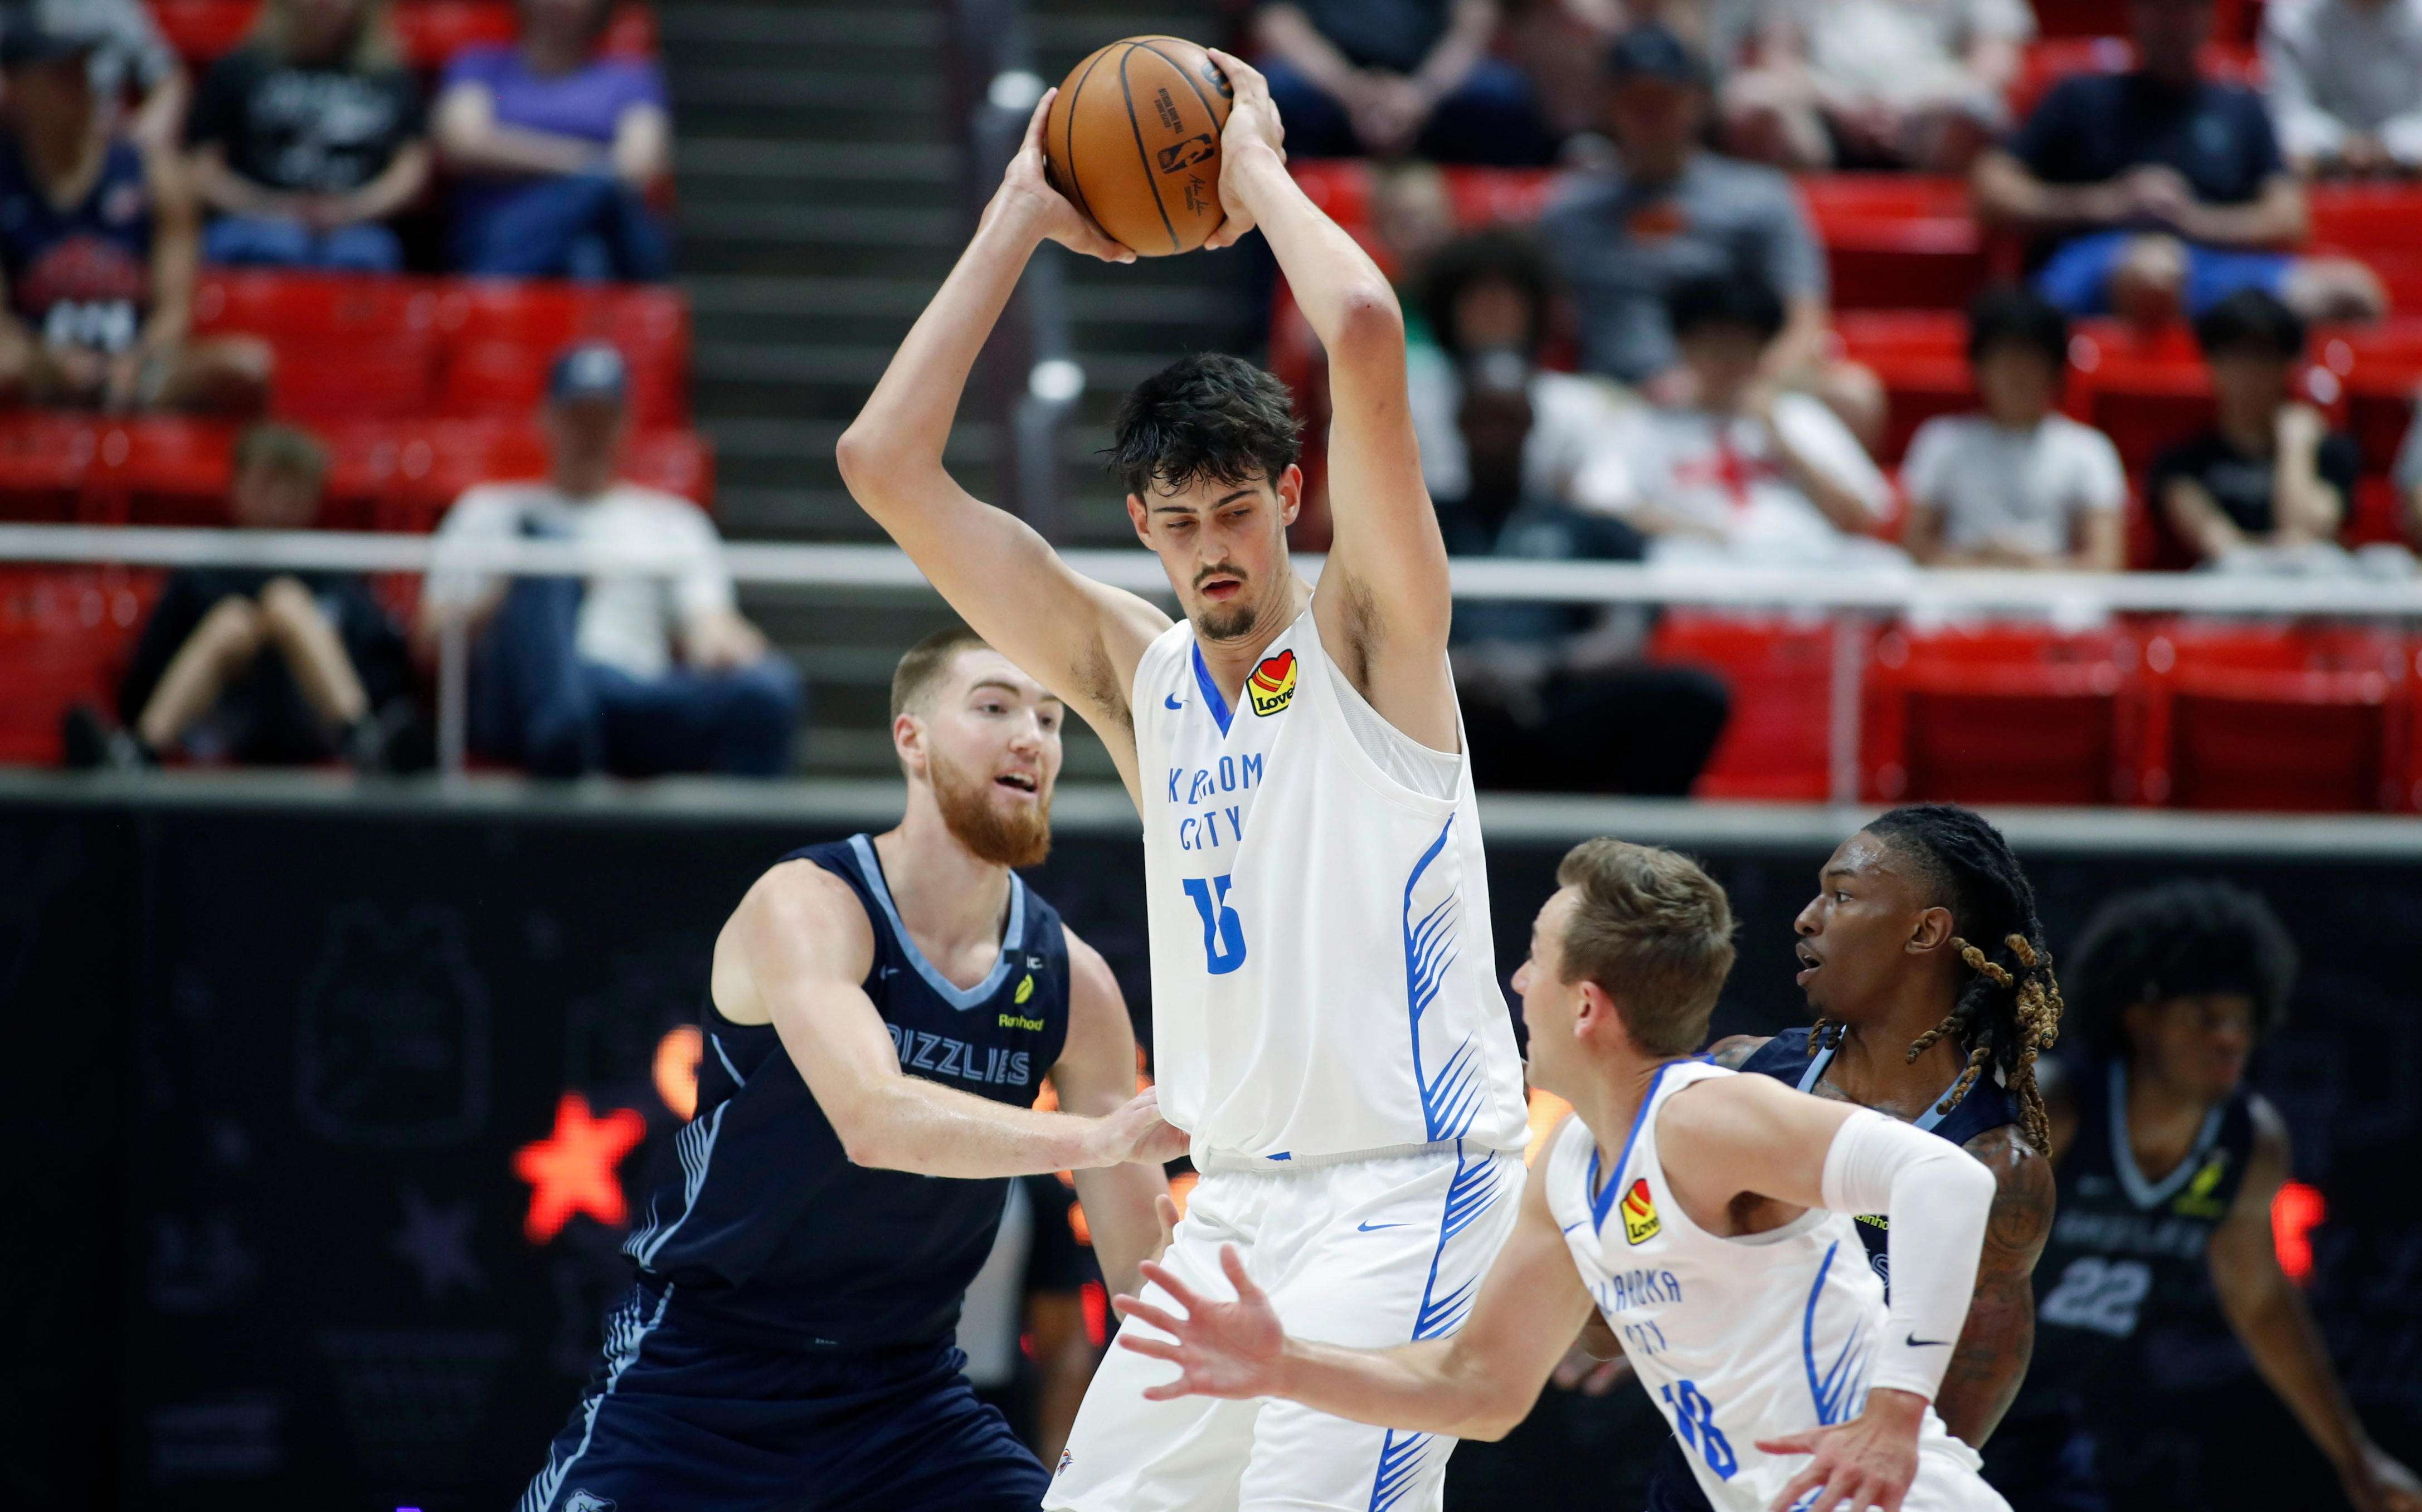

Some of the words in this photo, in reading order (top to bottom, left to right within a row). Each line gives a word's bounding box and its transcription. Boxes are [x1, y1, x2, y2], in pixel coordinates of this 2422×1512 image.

[1256, 687, 1295, 711] Love
[1182, 874, 1247, 975] 15
[2039, 1256, 2152, 1338] 22
[1661, 1380, 1738, 1482] 18
